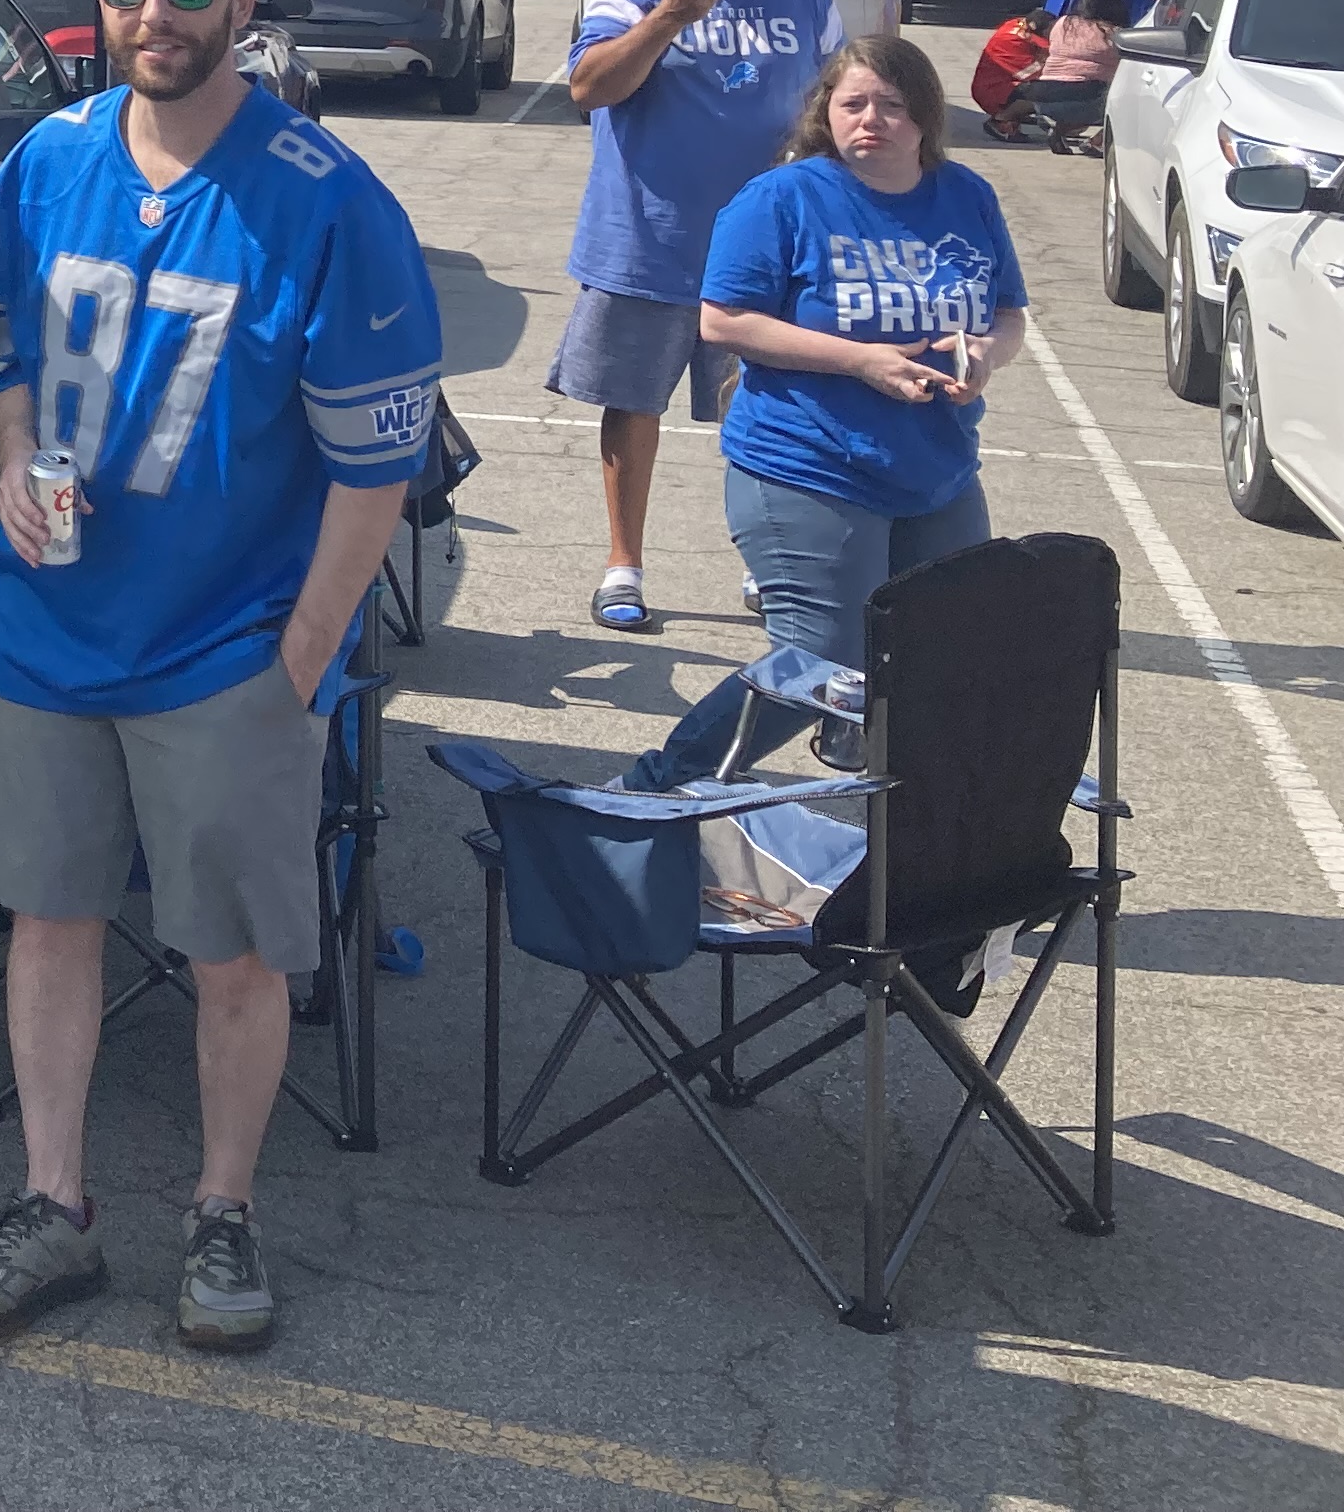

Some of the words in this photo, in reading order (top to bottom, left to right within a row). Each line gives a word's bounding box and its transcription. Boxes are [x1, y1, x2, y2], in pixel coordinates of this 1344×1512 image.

[707, 6, 765, 20] ETROIT
[829, 234, 934, 284] ONE
[835, 280, 991, 334] PRIDE
[38, 252, 240, 498] 87
[369, 390, 433, 437] WCF
